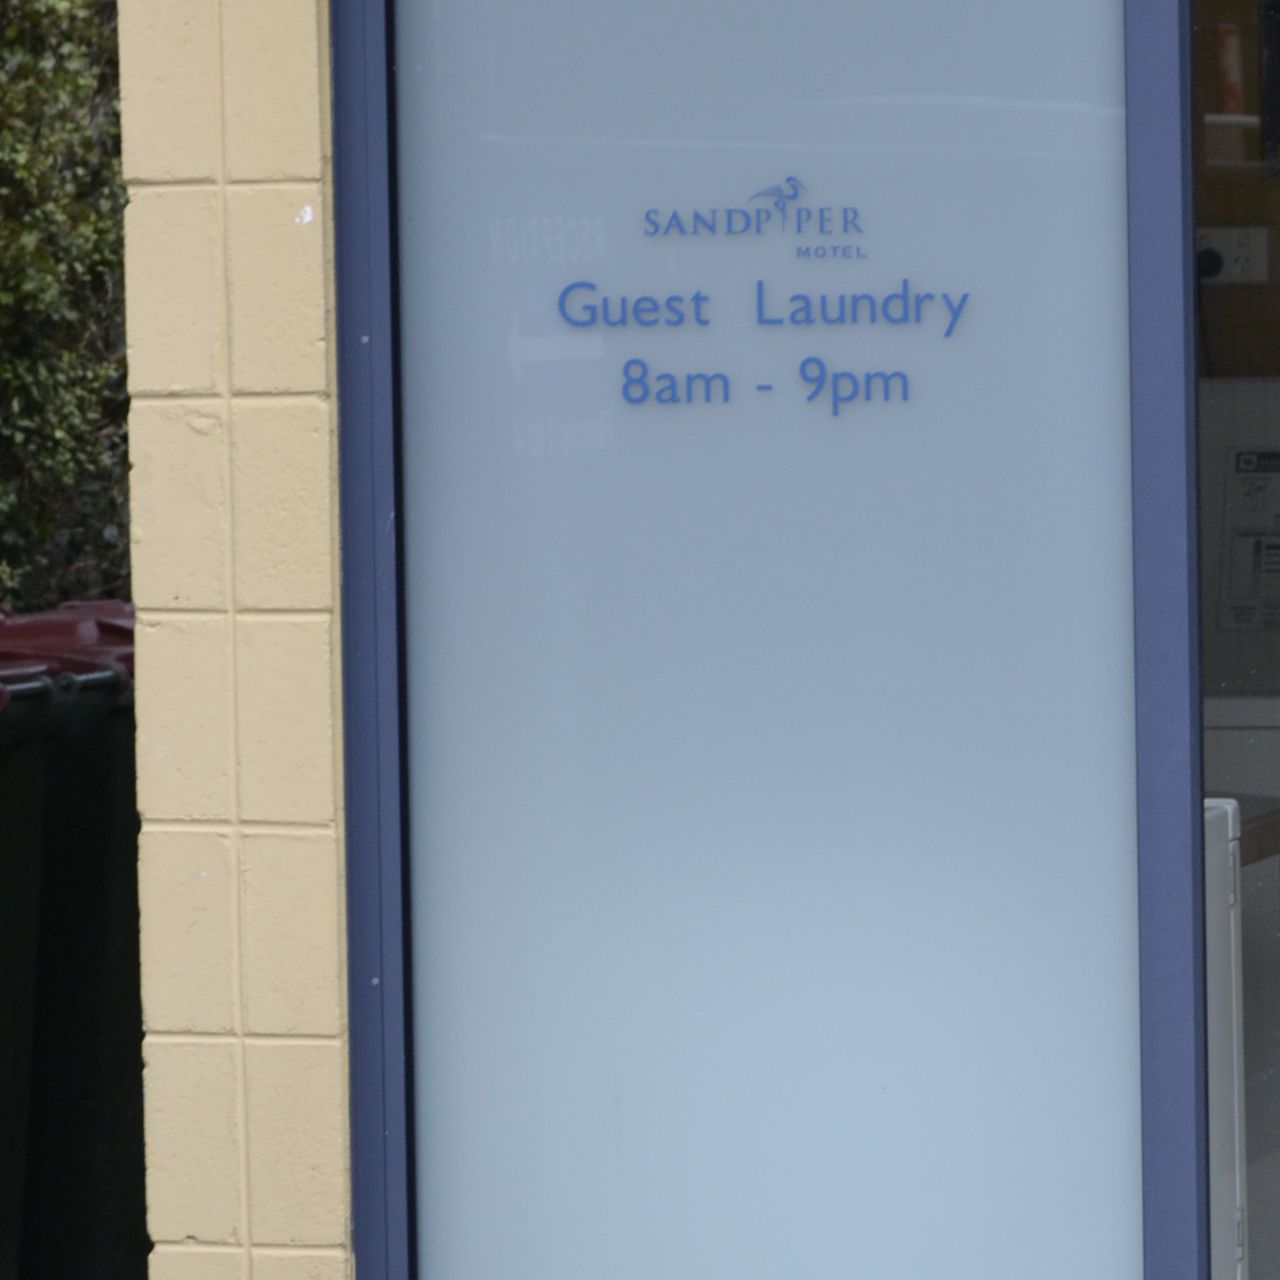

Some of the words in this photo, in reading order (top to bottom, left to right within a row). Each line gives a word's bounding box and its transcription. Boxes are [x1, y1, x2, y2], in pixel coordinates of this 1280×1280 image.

[795, 244, 868, 260] MOTEL
[557, 280, 711, 329] Guest
[755, 277, 971, 339] Laundry
[621, 357, 731, 406] 8am
[755, 383, 774, 393] -
[798, 355, 910, 418] 9pm
